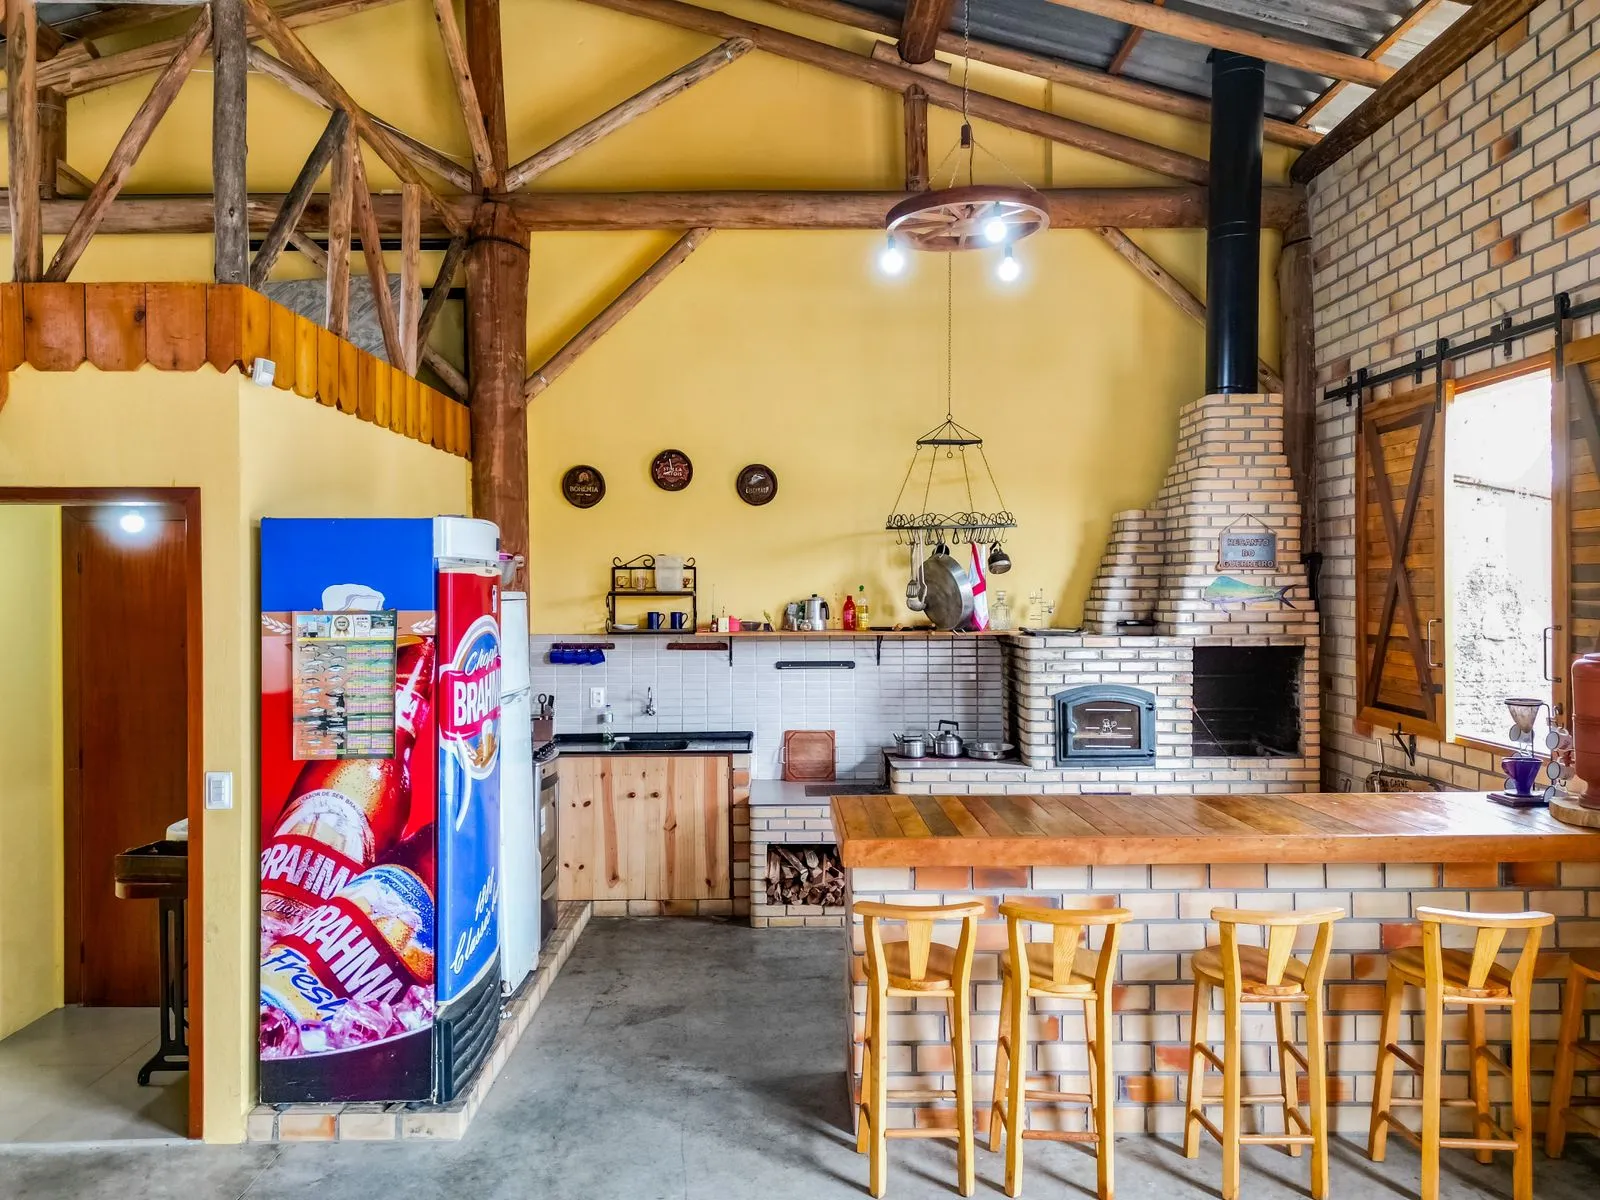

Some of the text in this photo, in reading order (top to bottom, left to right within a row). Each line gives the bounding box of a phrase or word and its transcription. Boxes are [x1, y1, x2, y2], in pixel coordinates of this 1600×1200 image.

[570, 485, 599, 493] BOHEMIA
[1227, 538, 1269, 546] RECANTO
[1241, 549, 1255, 557] DO
[1223, 560, 1274, 568] GUERREIRO
[332, 792, 344, 800] SER
[292, 905, 403, 1006] BRAHMA
[261, 948, 349, 1022] Fresh
